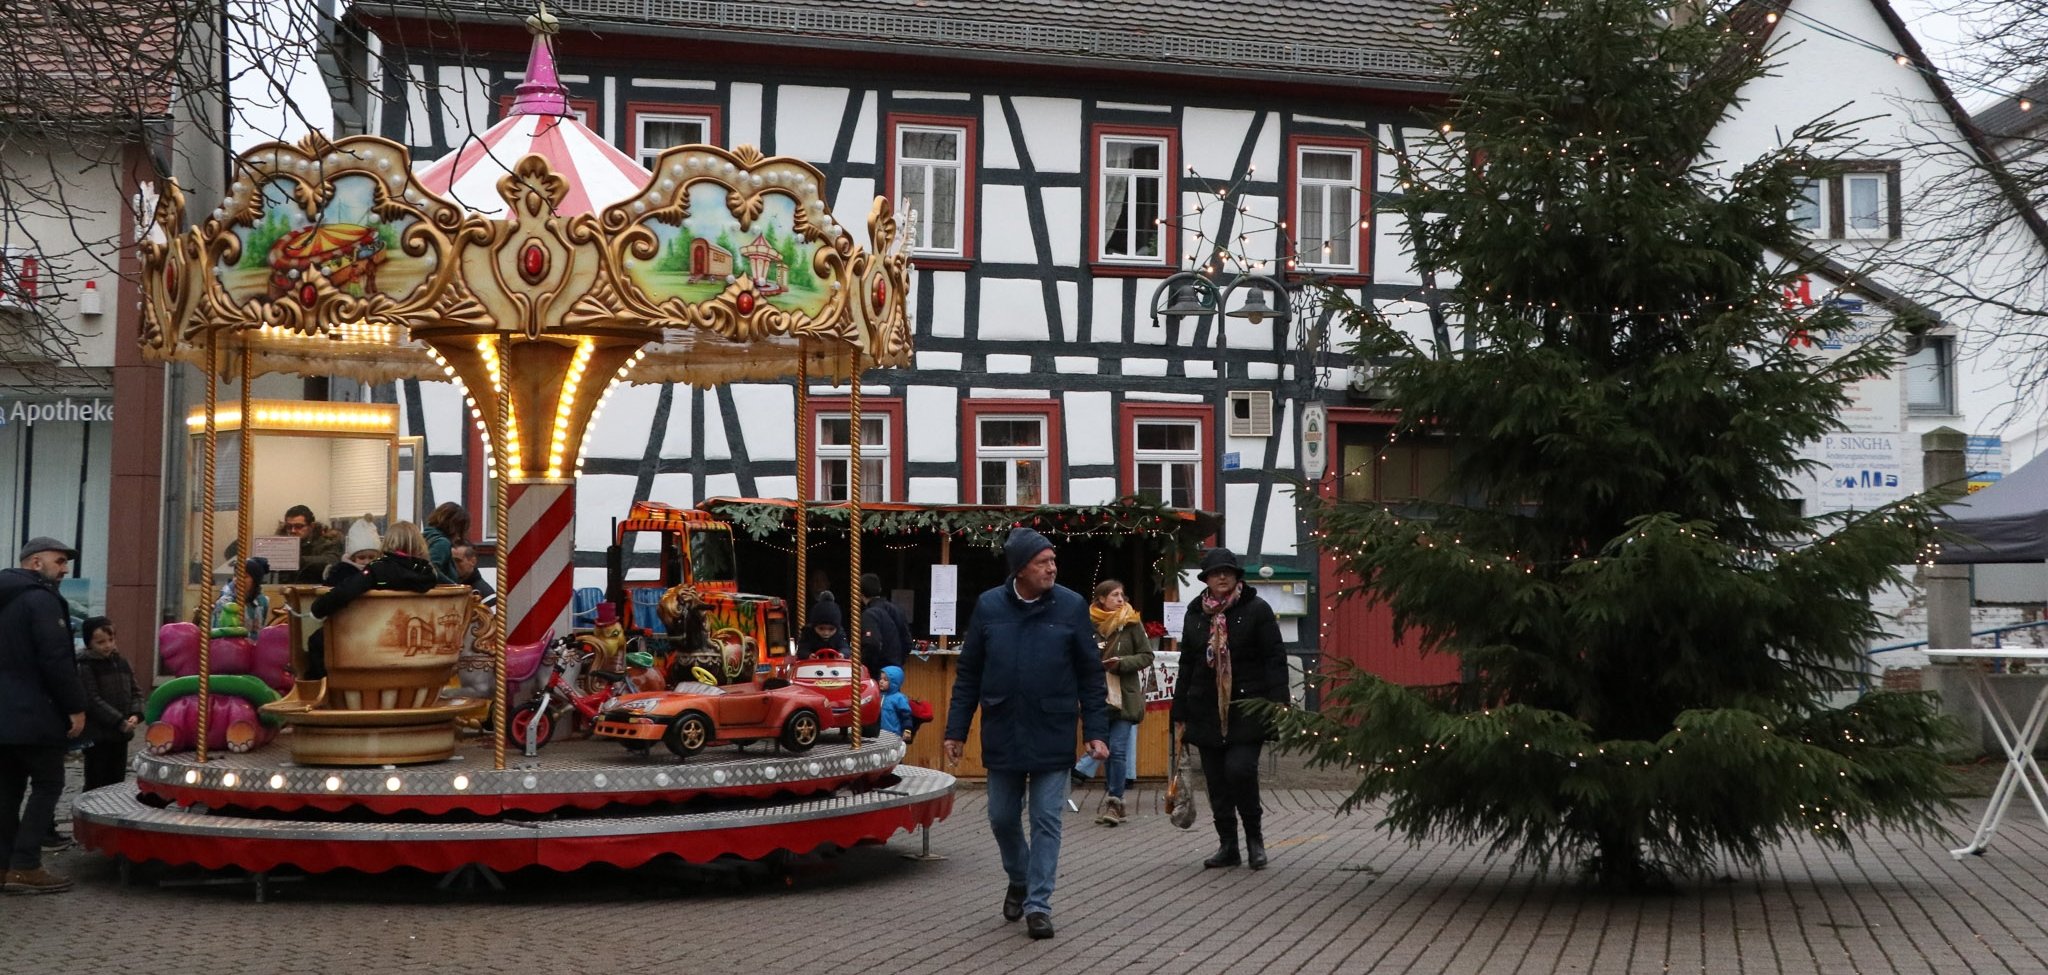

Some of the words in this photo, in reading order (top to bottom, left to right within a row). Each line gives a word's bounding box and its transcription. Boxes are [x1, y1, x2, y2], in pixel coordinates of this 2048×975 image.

[10, 398, 114, 427] Apotheke
[1825, 437, 1836, 449] P.
[1841, 437, 1892, 450] SINGHA
